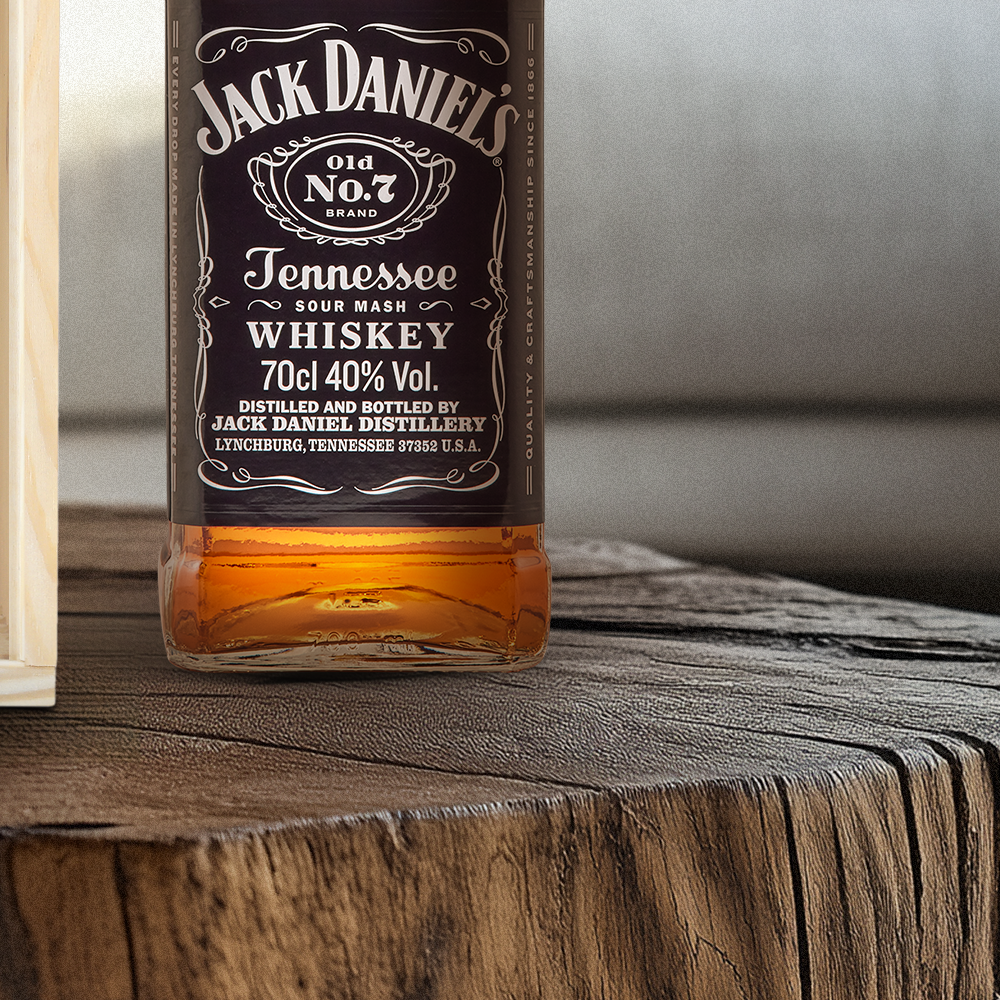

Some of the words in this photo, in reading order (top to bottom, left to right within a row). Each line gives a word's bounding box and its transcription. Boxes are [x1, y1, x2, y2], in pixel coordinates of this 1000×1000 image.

[527, 57, 535, 100] 1866
[190, 59, 321, 156] JACK
[171, 116, 179, 162] DROP
[527, 108, 535, 167] SINCE
[326, 154, 374, 171] Old
[303, 174, 398, 202] No.7
[325, 208, 378, 218] BRAND
[170, 221, 177, 238] IN
[243, 246, 458, 291] Tennessee
[526, 175, 534, 346] CRAFTSMANSHIP
[295, 300, 345, 313] SOUR
[354, 300, 407, 313] MASH
[246, 321, 455, 350] WHISKEY
[526, 353, 534, 365] &
[260, 360, 318, 391] 70cl
[325, 360, 385, 392] 40%
[392, 361, 439, 391] Vol.
[239, 400, 320, 414] DISTILLED
[323, 401, 357, 414] AND
[361, 401, 433, 414] BOTTLED
[438, 401, 460, 414] BY
[526, 372, 534, 460] QUALITY
[211, 416, 267, 432] JACK
[271, 416, 353, 432] DANIEL
[358, 416, 487, 433] DISTILLERY
[215, 438, 307, 454] LYNCHBURG,
[308, 438, 394, 452] TENNESSEE
[398, 439, 438, 453] 37352
[441, 439, 481, 453] U.S.A.
